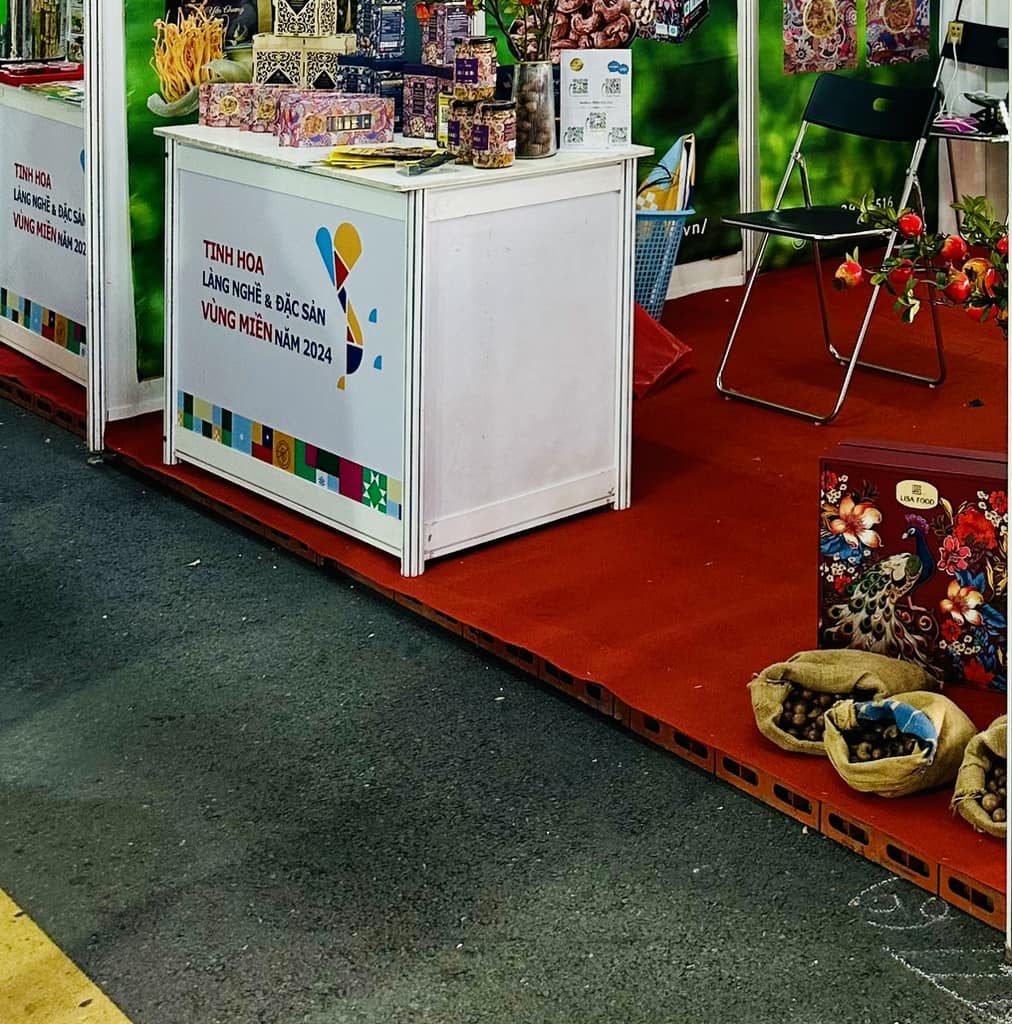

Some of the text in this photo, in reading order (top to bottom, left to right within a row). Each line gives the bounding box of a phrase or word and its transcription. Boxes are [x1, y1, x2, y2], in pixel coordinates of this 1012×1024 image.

[14, 162, 52, 190] TINH HOA
[14, 184, 31, 207] LÀNG
[32, 195, 51, 213] NGHỀ
[52, 204, 57, 216] &
[58, 203, 72, 223] ĐẶC
[13, 209, 86, 256] VÙNG MIỀN NĂM 202
[203, 239, 265, 275] TINH HOA
[202, 267, 326, 326] LÀNG NGHỀ & ĐẶC SẢN
[201, 298, 333, 364] VÙNG MIỀN NĂM 2024
[916, 497, 935, 505] FOOD
